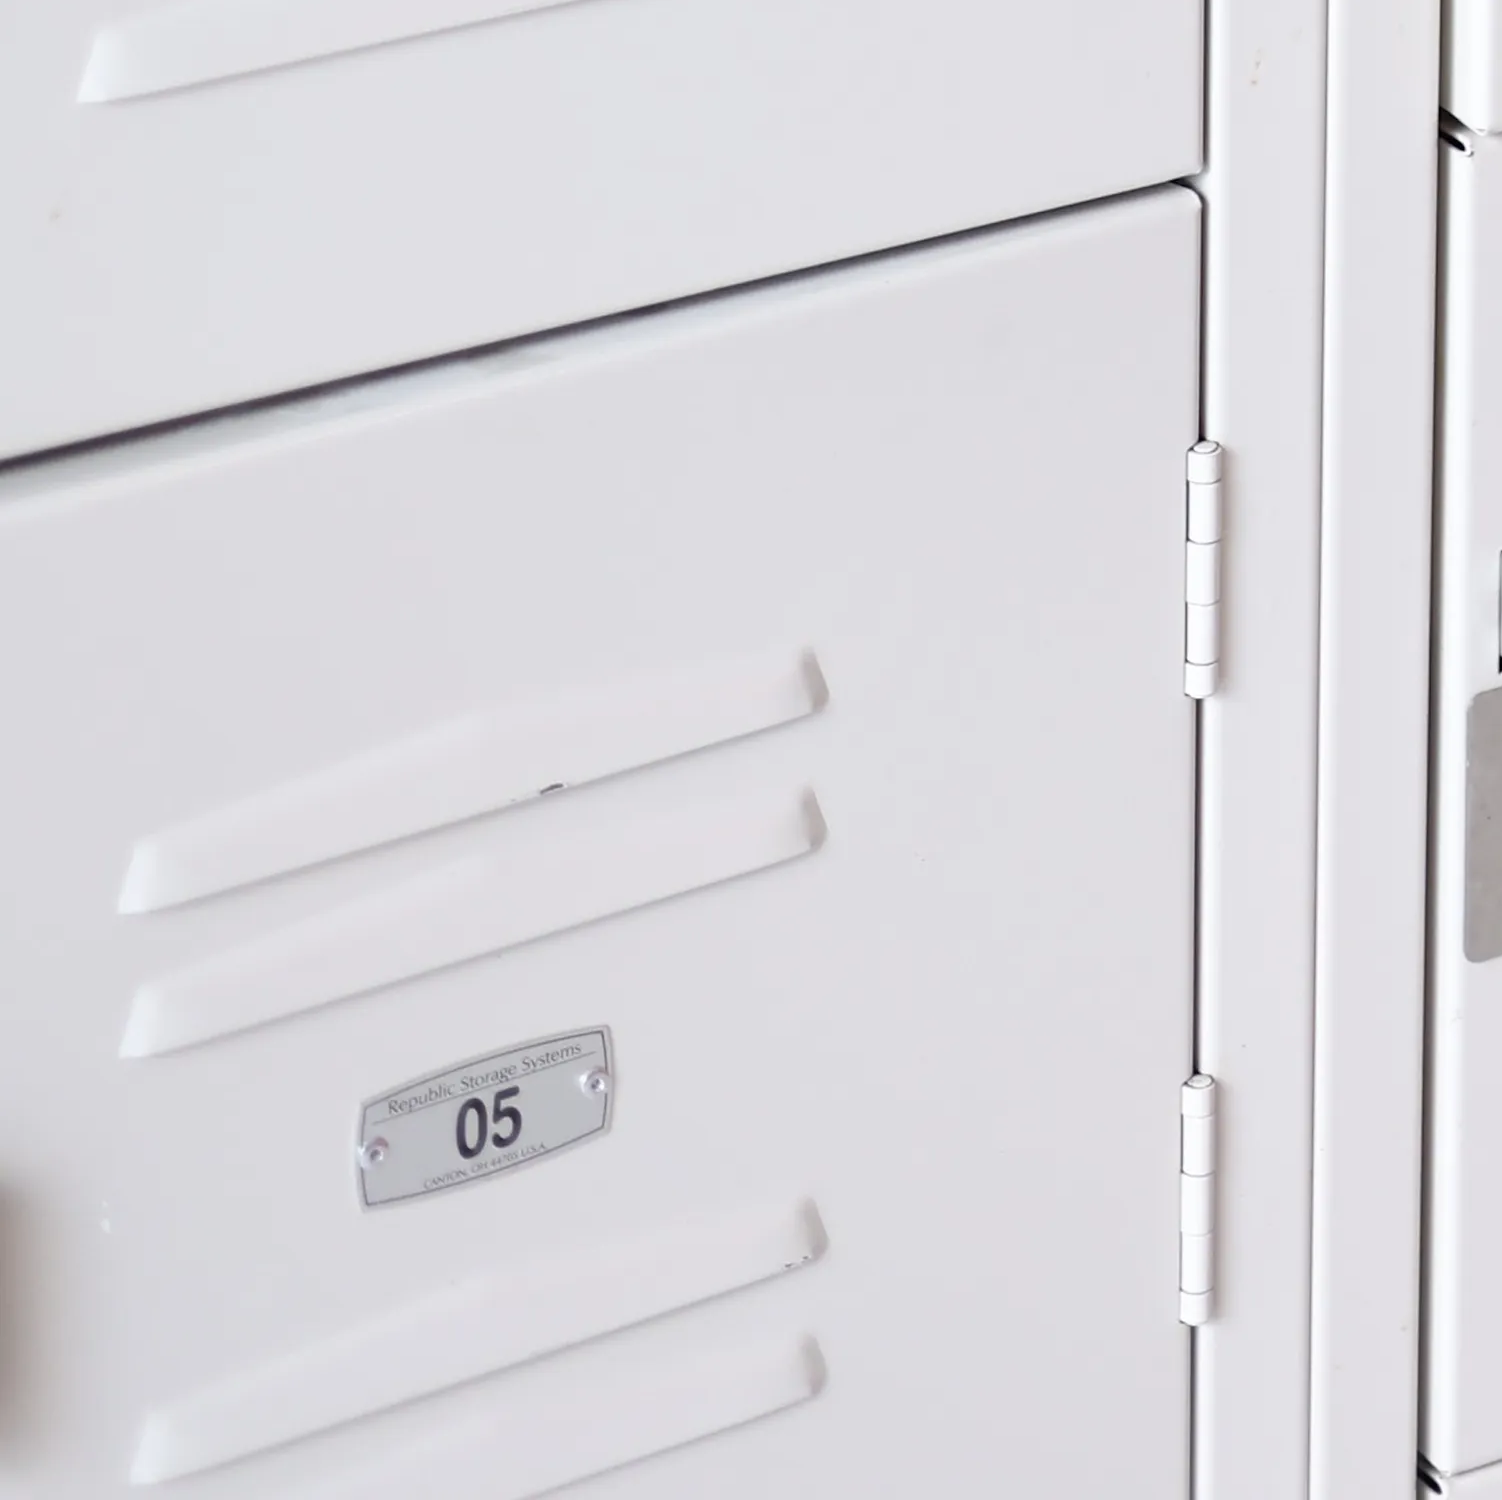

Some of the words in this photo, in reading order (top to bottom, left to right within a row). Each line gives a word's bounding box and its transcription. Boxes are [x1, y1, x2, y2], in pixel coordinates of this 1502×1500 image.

[387, 1083, 454, 1115] Republic
[460, 1063, 517, 1090] Storage
[522, 1043, 582, 1072] Systems
[456, 1085, 522, 1160] 05
